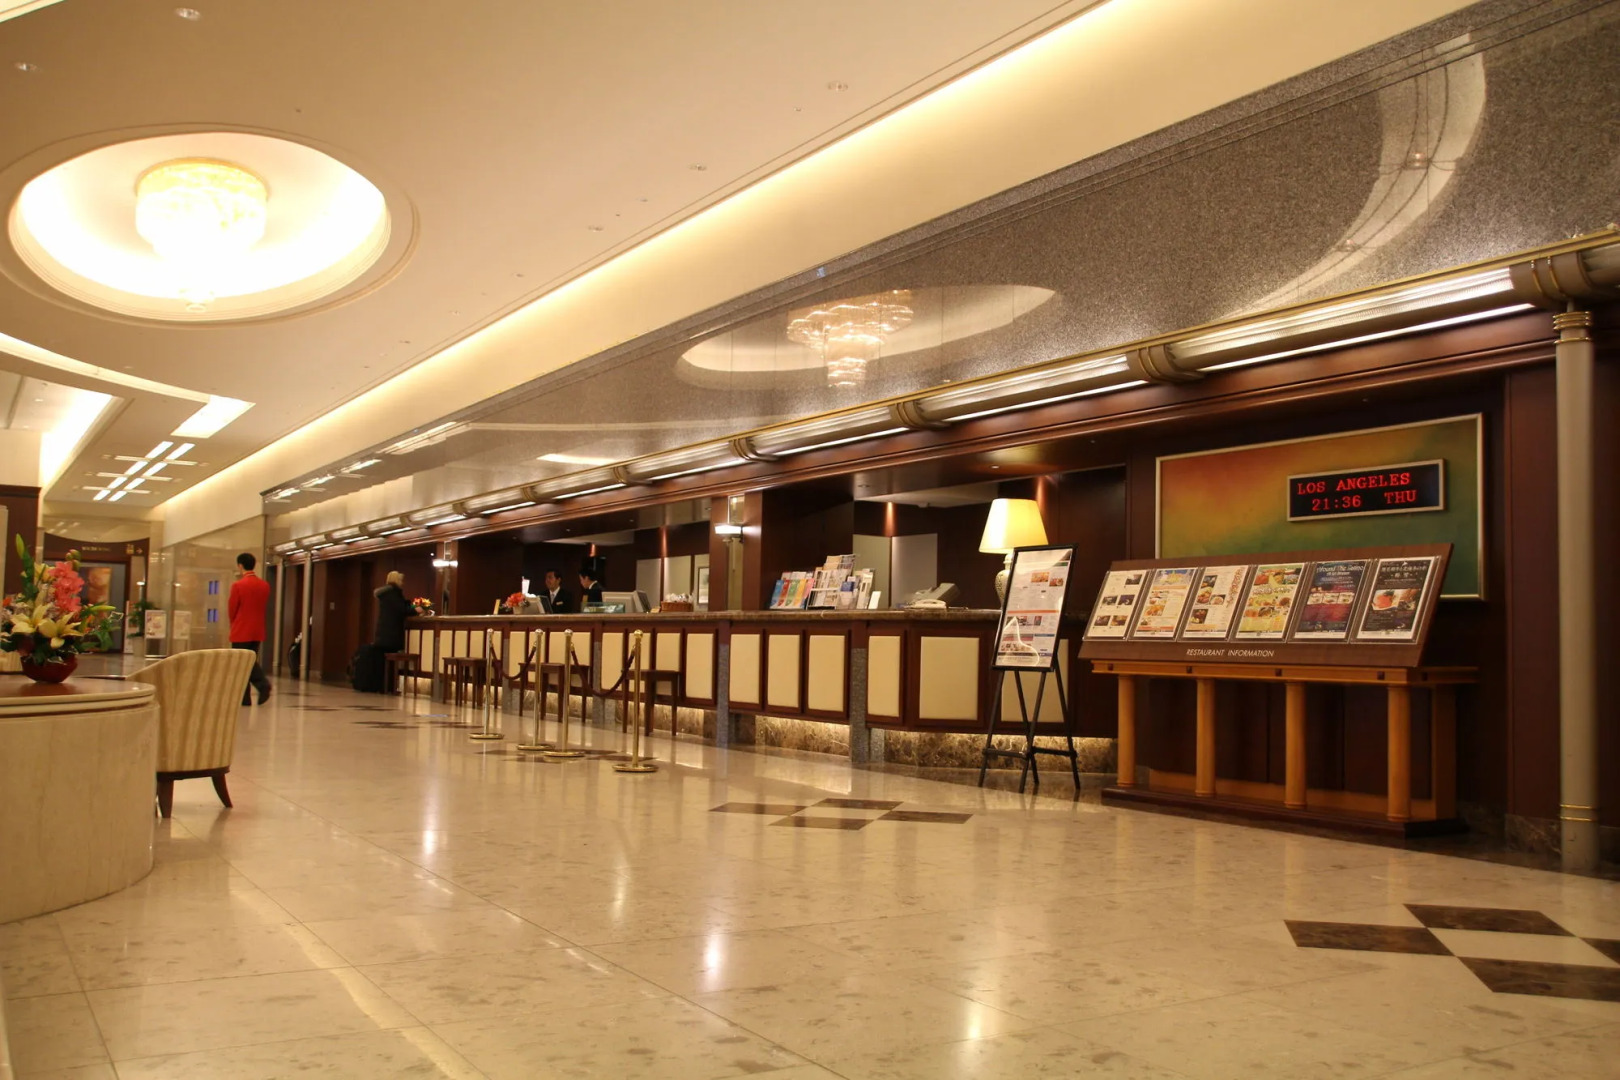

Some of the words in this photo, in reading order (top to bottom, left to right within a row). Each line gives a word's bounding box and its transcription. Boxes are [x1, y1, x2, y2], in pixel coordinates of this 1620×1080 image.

[1297, 481, 1326, 495] LOS
[1335, 472, 1410, 491] ANGELES
[1312, 495, 1361, 511] 21:36
[1384, 490, 1417, 504] THU
[1186, 648, 1225, 656] RESTAURANT
[1227, 649, 1274, 657] INFORMATION
